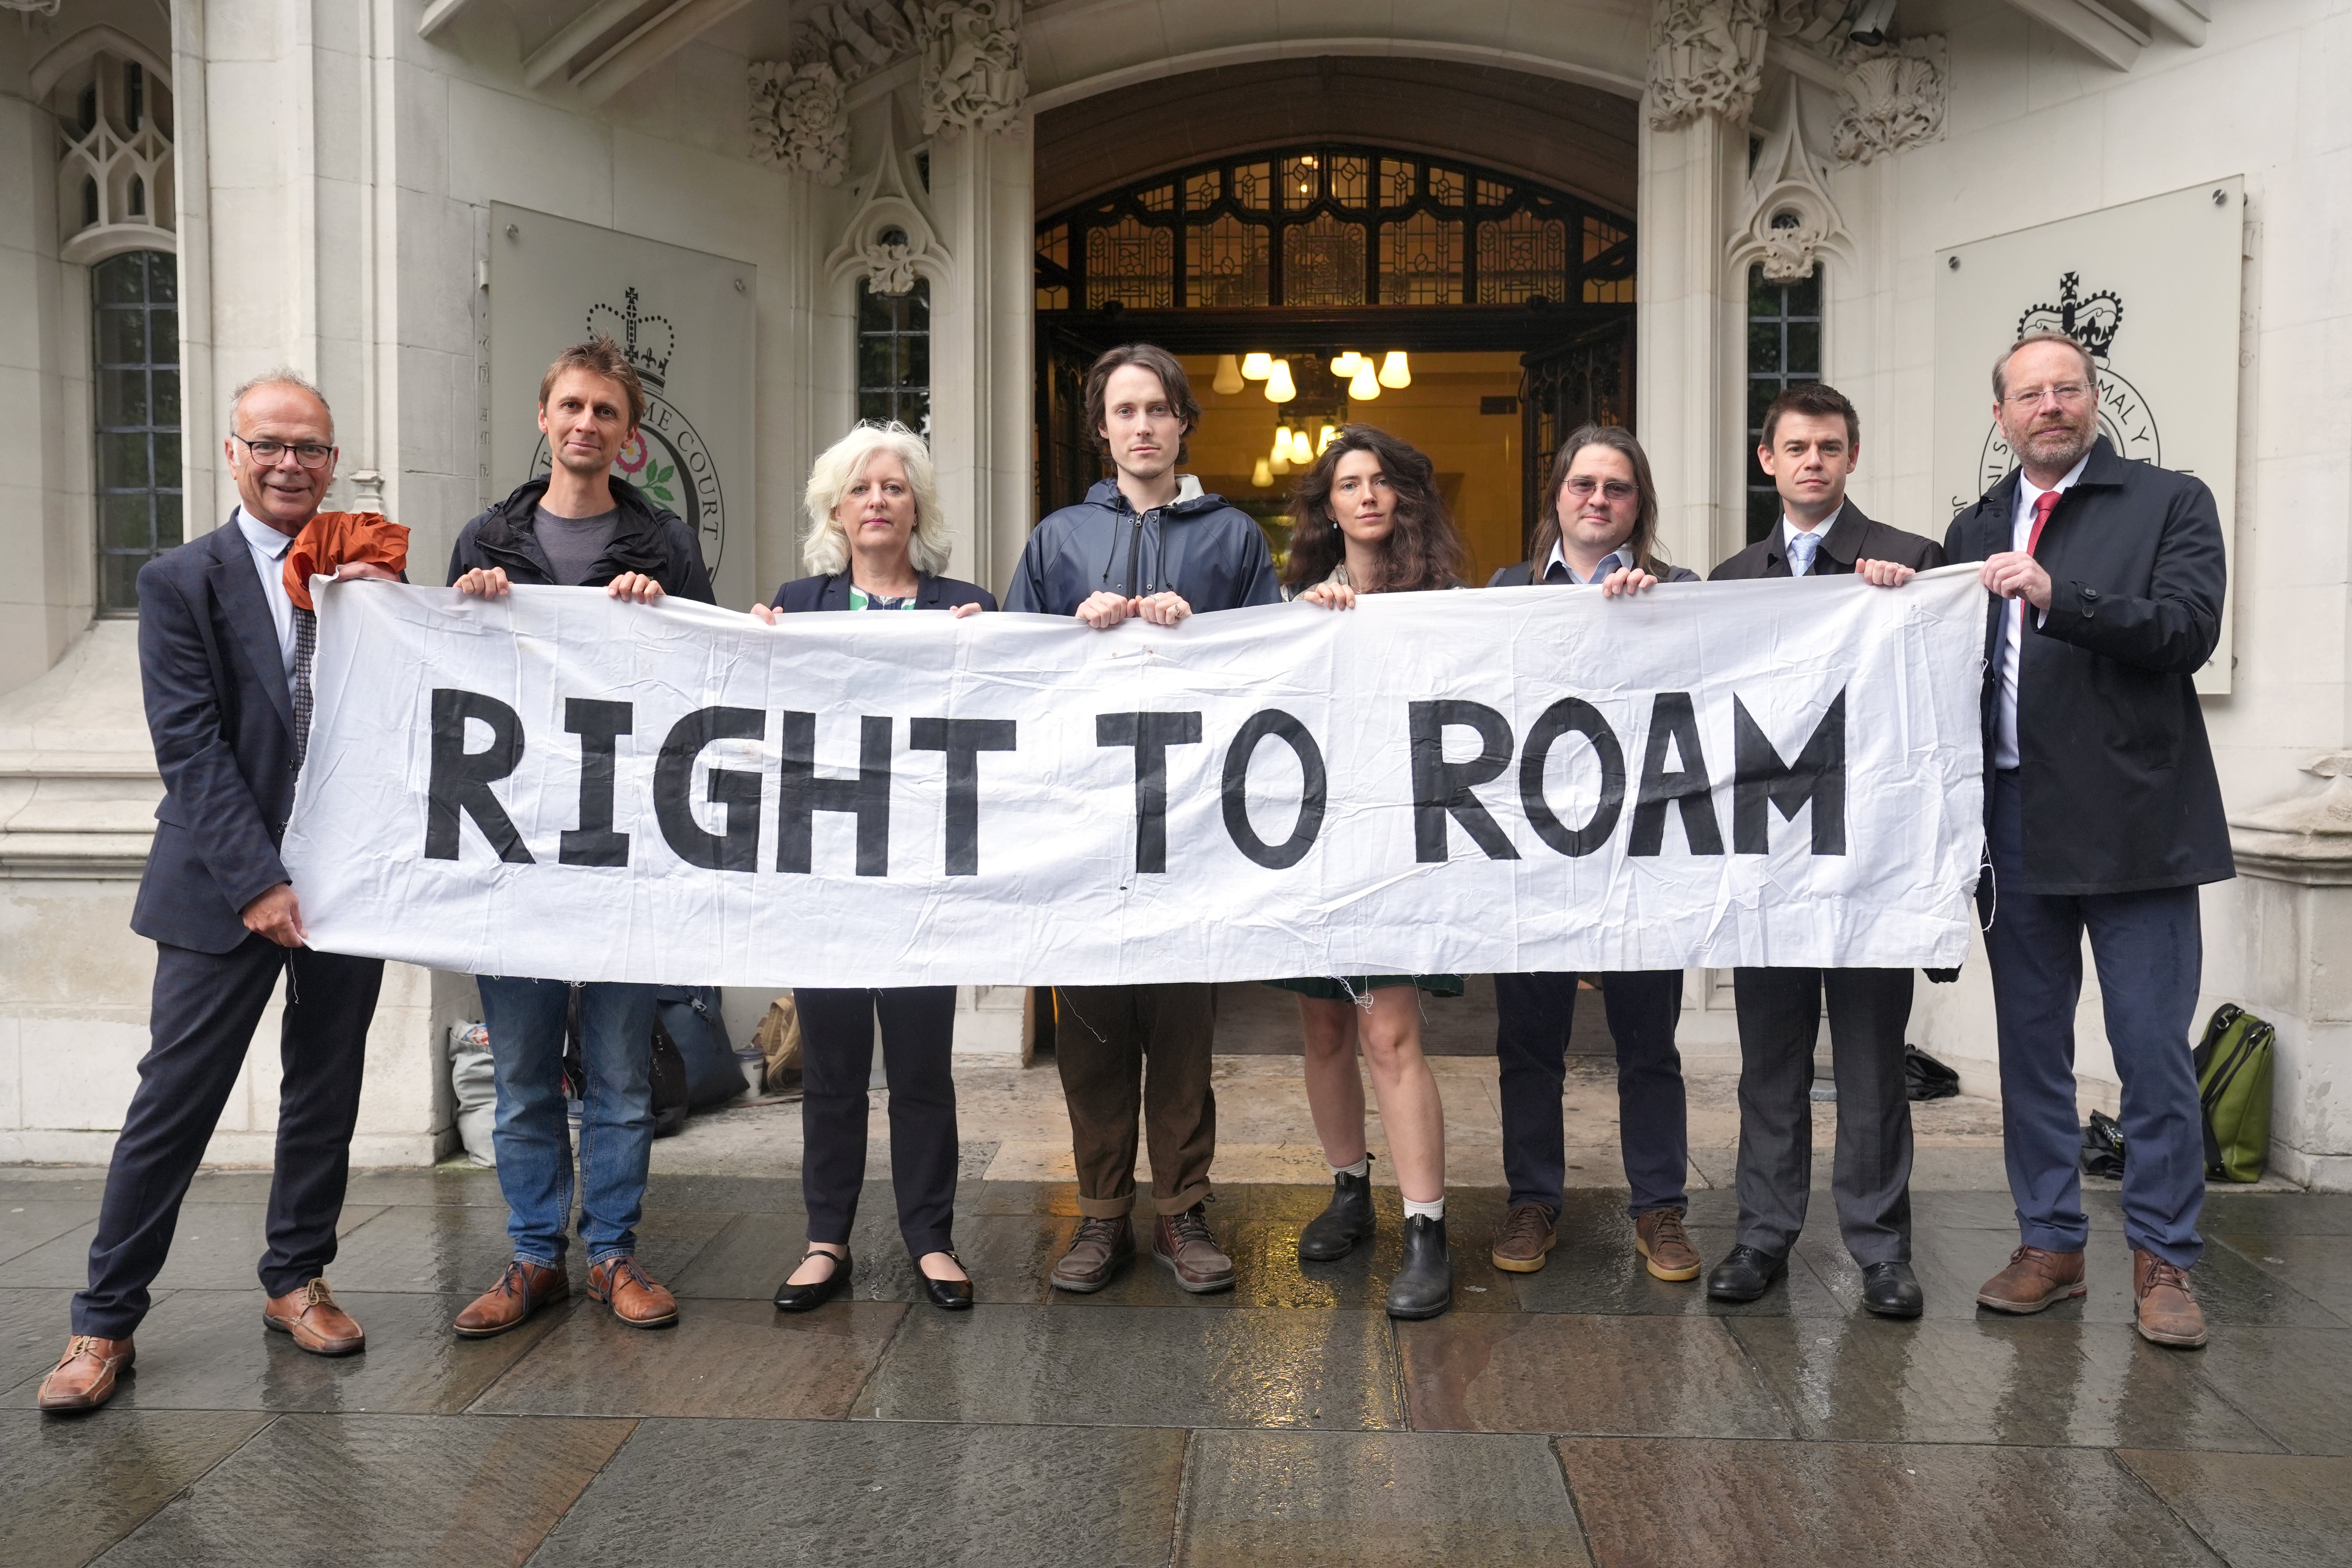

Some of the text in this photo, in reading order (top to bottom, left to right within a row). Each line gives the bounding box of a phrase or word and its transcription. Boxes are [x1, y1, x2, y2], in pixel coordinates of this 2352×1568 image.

[2098, 378, 2135, 425] MAL
[2131, 425, 2149, 442] Y
[677, 431, 719, 541] COURT
[425, 684, 1846, 877] RIGHT TO ROAM
